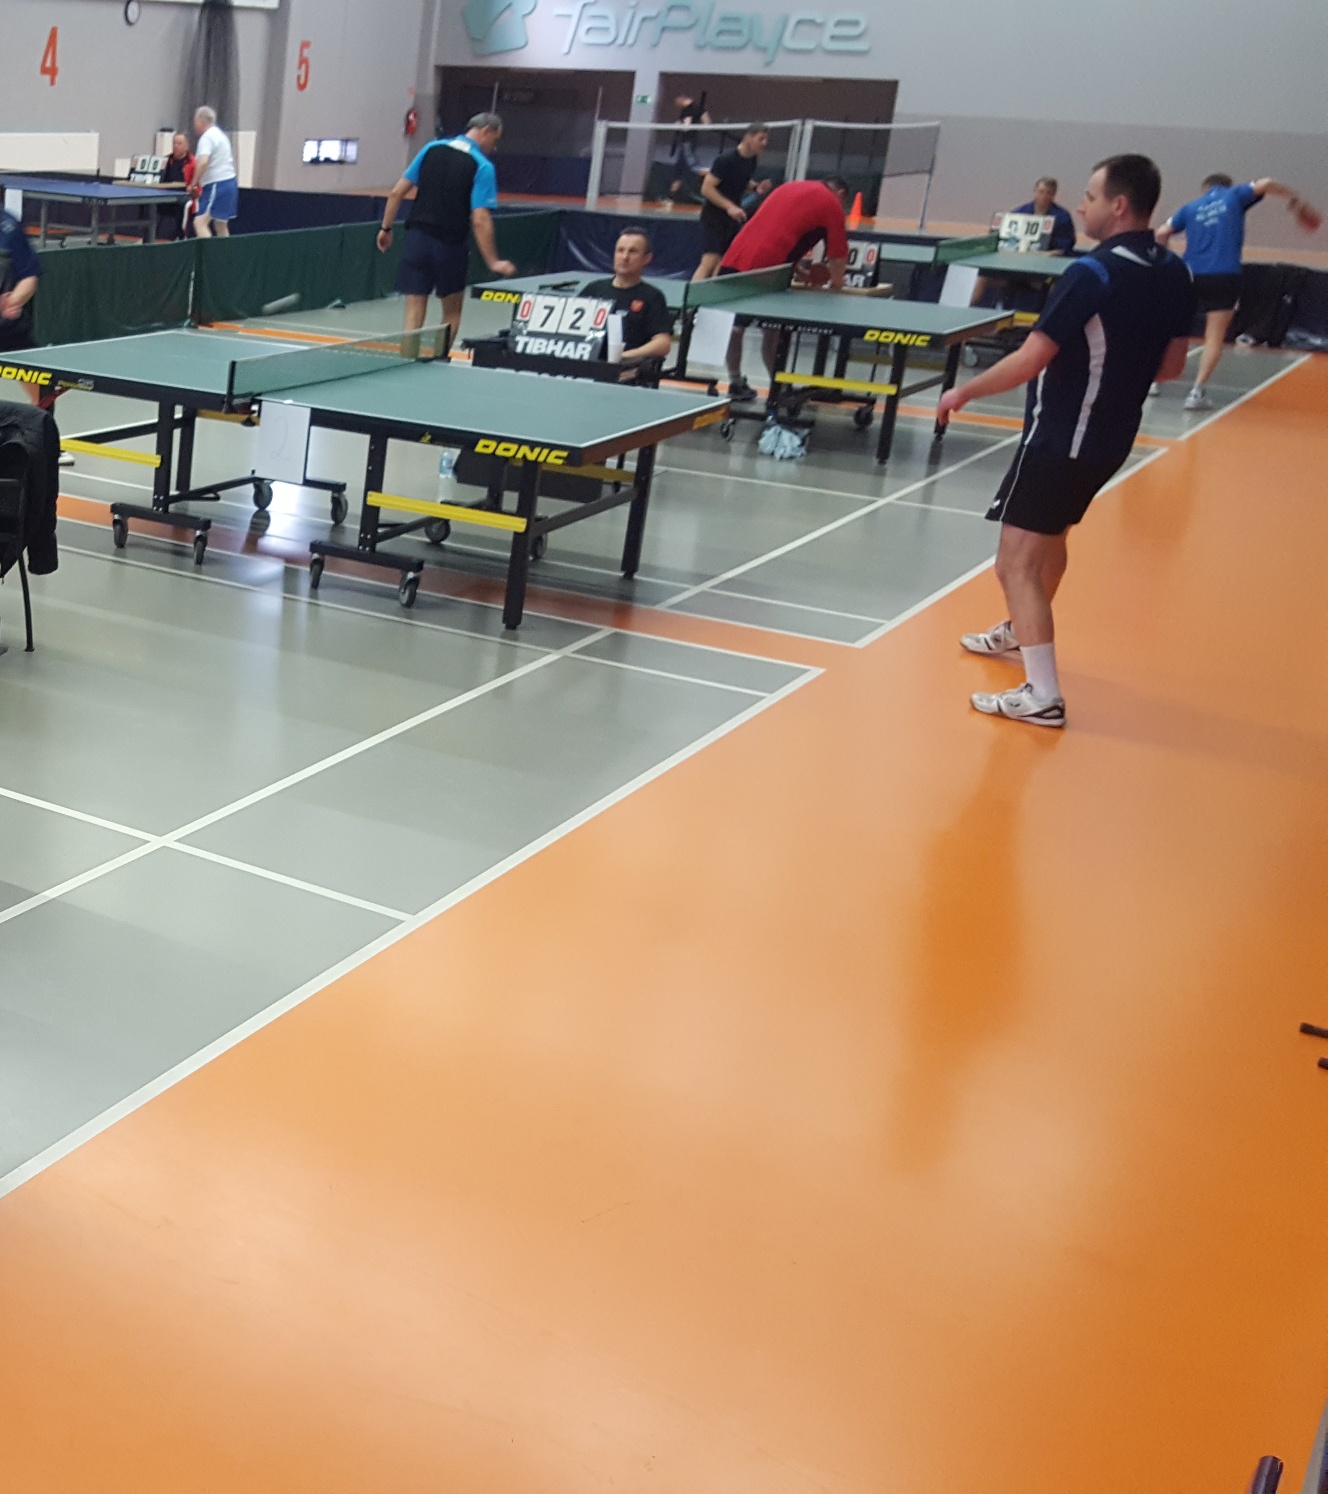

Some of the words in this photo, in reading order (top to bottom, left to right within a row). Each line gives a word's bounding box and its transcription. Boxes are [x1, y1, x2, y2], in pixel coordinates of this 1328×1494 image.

[40, 25, 59, 87] 4
[296, 40, 311, 92] 5
[481, 290, 520, 304] DON
[519, 300, 533, 319] 0
[540, 305, 555, 328] 7
[569, 308, 586, 330] 2
[593, 308, 607, 327] 0
[515, 335, 592, 361] TIBHAR
[863, 328, 932, 347] DONIC
[474, 438, 570, 465] DONIC
